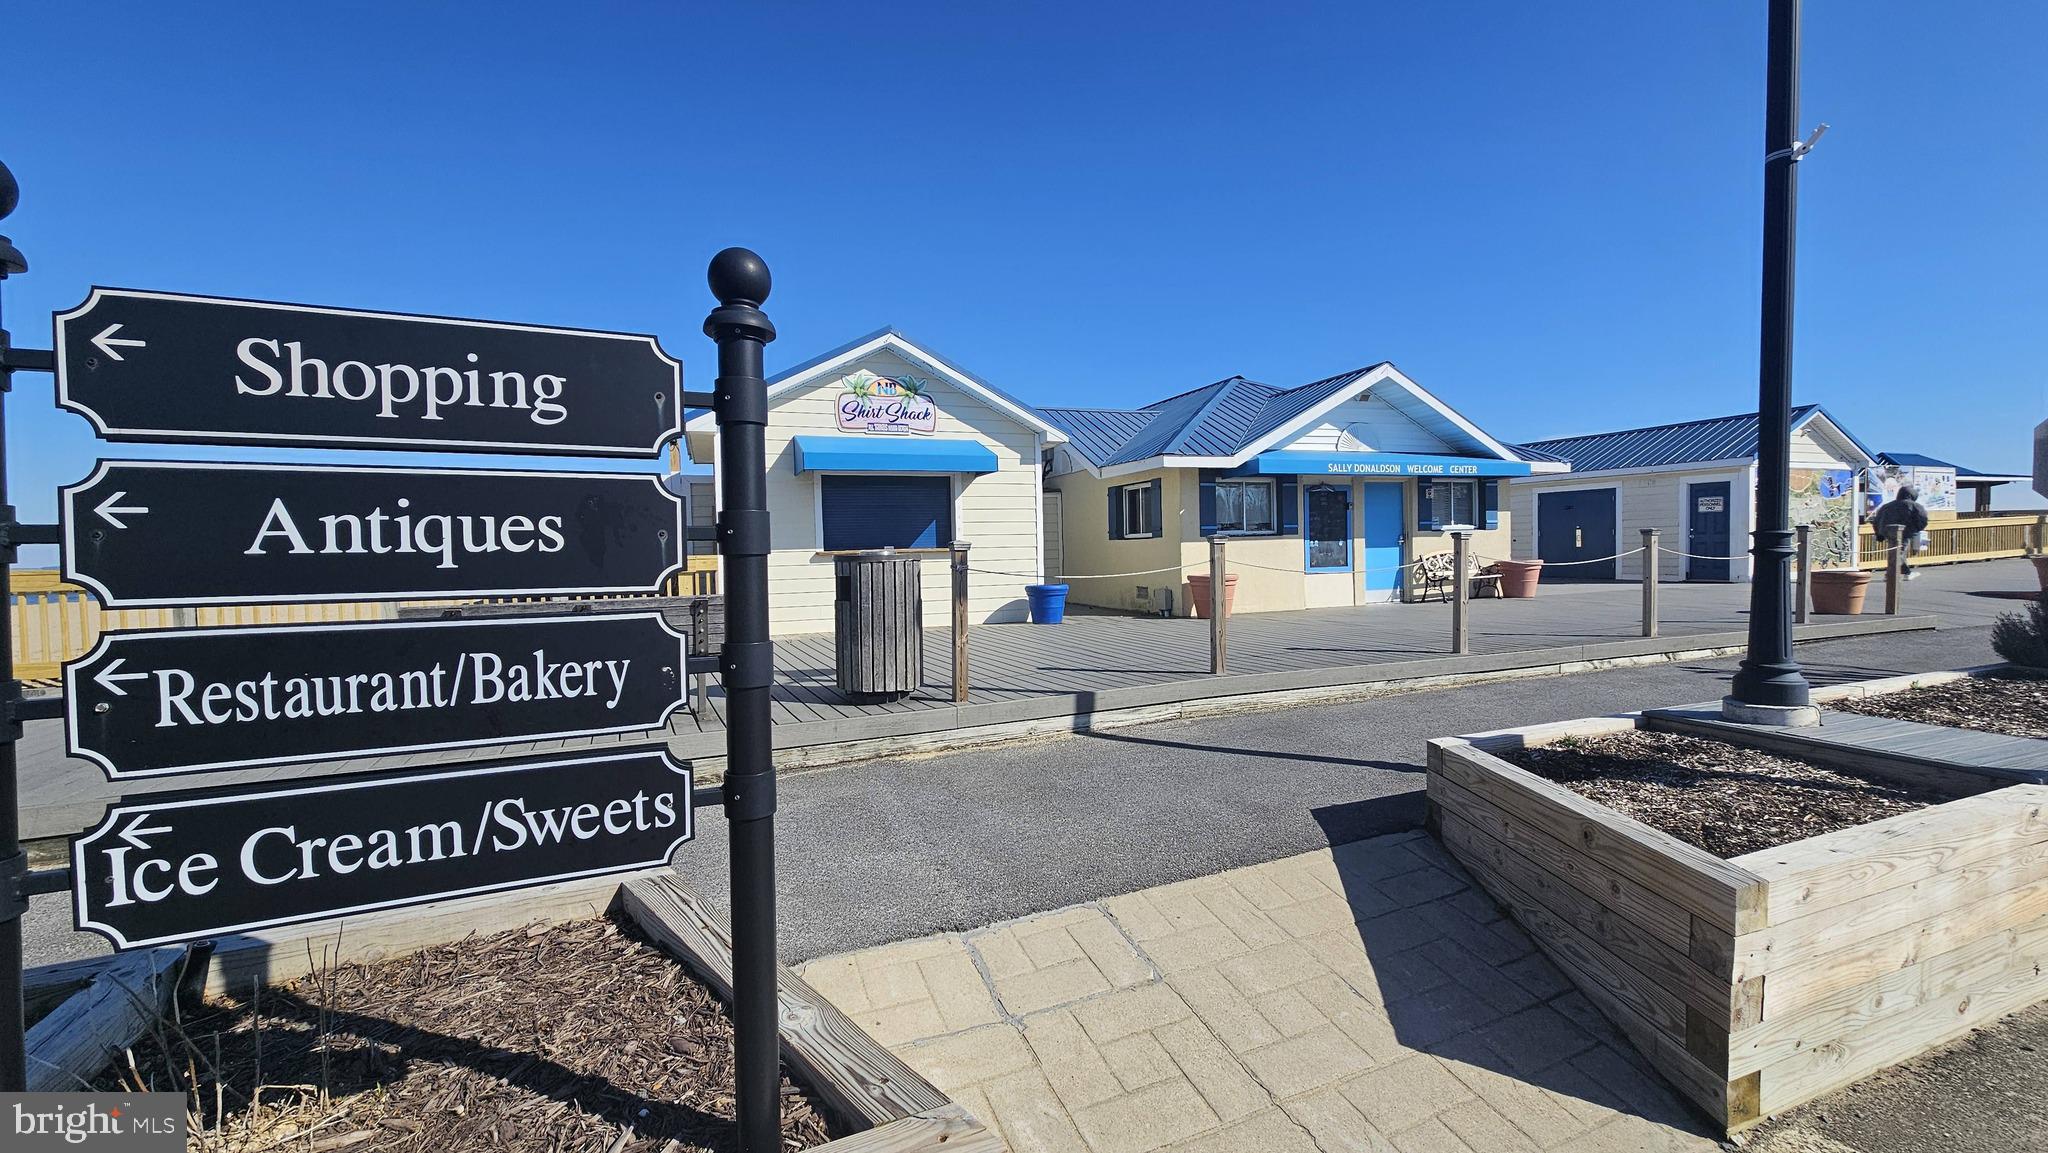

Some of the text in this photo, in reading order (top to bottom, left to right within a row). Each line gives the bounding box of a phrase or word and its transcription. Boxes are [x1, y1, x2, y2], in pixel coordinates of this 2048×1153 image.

[234, 337, 567, 426] Shopping
[842, 400, 933, 423] Shirt Shack
[1328, 463, 1477, 474] SALLY DONALDSON WELCOME CENTER
[243, 497, 565, 569] Antiques
[152, 651, 631, 728] Restaurant/Bakery
[102, 847, 218, 907] Ice
